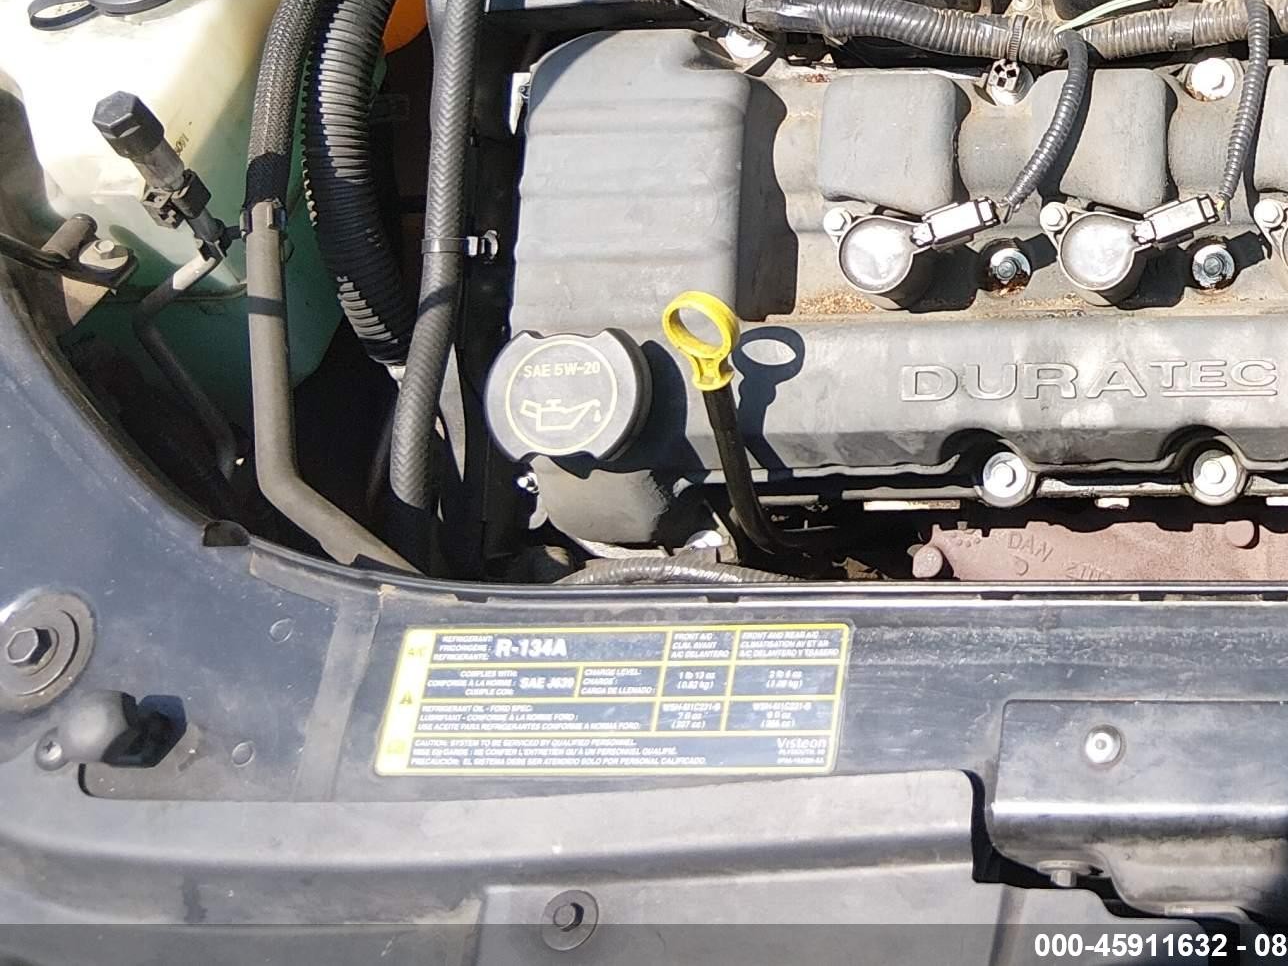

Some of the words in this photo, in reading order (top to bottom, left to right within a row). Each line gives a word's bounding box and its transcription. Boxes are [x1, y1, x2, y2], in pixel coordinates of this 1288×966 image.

[523, 364, 551, 378] SAE
[554, 361, 600, 376] 5W-20
[900, 359, 1278, 402] DURATEC
[494, 638, 567, 657] R-134A
[520, 677, 546, 690] SAE
[776, 737, 828, 750] Visteon
